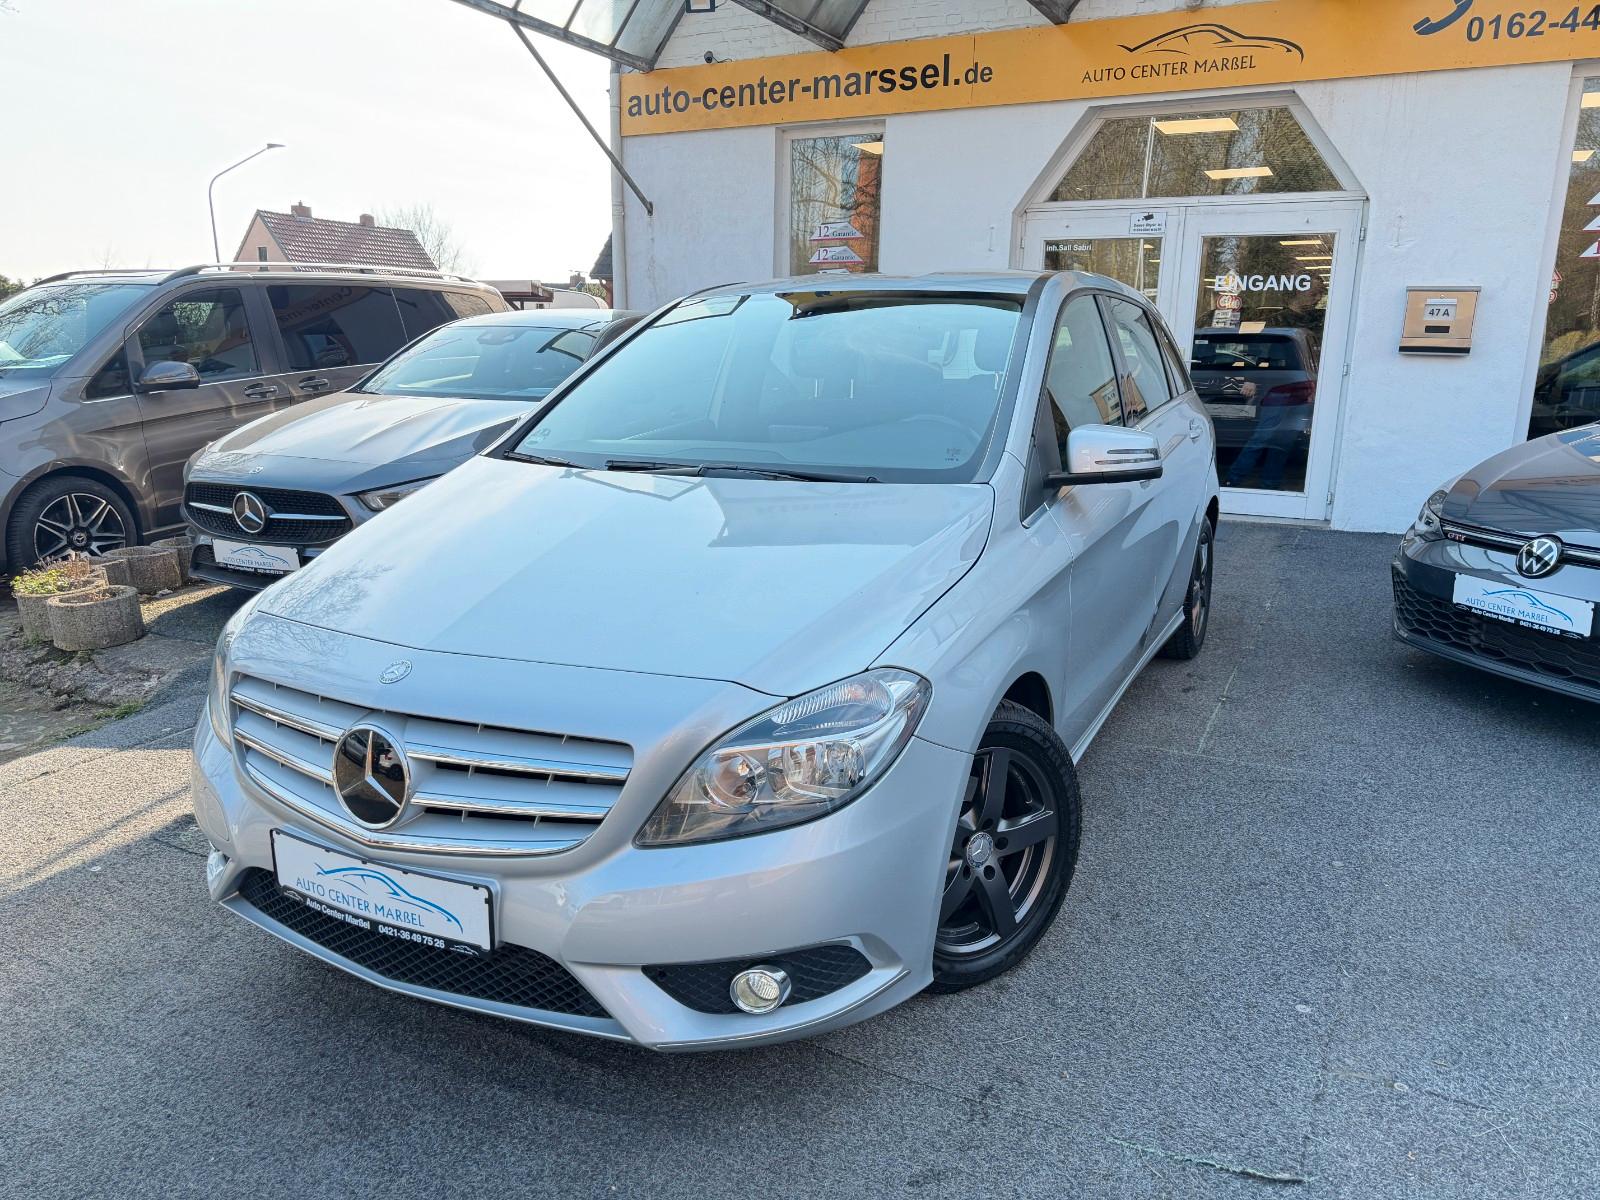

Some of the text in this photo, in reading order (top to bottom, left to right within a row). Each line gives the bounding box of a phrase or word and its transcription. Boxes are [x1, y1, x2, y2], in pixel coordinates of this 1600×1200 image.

[1466, 4, 1600, 42] 0162-44
[1081, 66, 1126, 83] AUTO
[1130, 61, 1189, 79] CENTER
[627, 53, 993, 117] auto-center-marssel.de
[817, 225, 830, 238] 12
[816, 248, 829, 261] 12
[1214, 274, 1311, 291] EINGANG
[1428, 308, 1450, 317] 47 A
[1465, 597, 1486, 608] AUTO
[1487, 602, 1516, 616] CENTER
[296, 876, 325, 897] AUTO
[328, 888, 371, 913] CENTER
[306, 897, 321, 911] Auto
[321, 904, 345, 920] Center
[378, 924, 411, 940] 0421-36
[411, 932, 422, 943] 49
[422, 935, 434, 946] 75
[433, 938, 445, 949] 26
